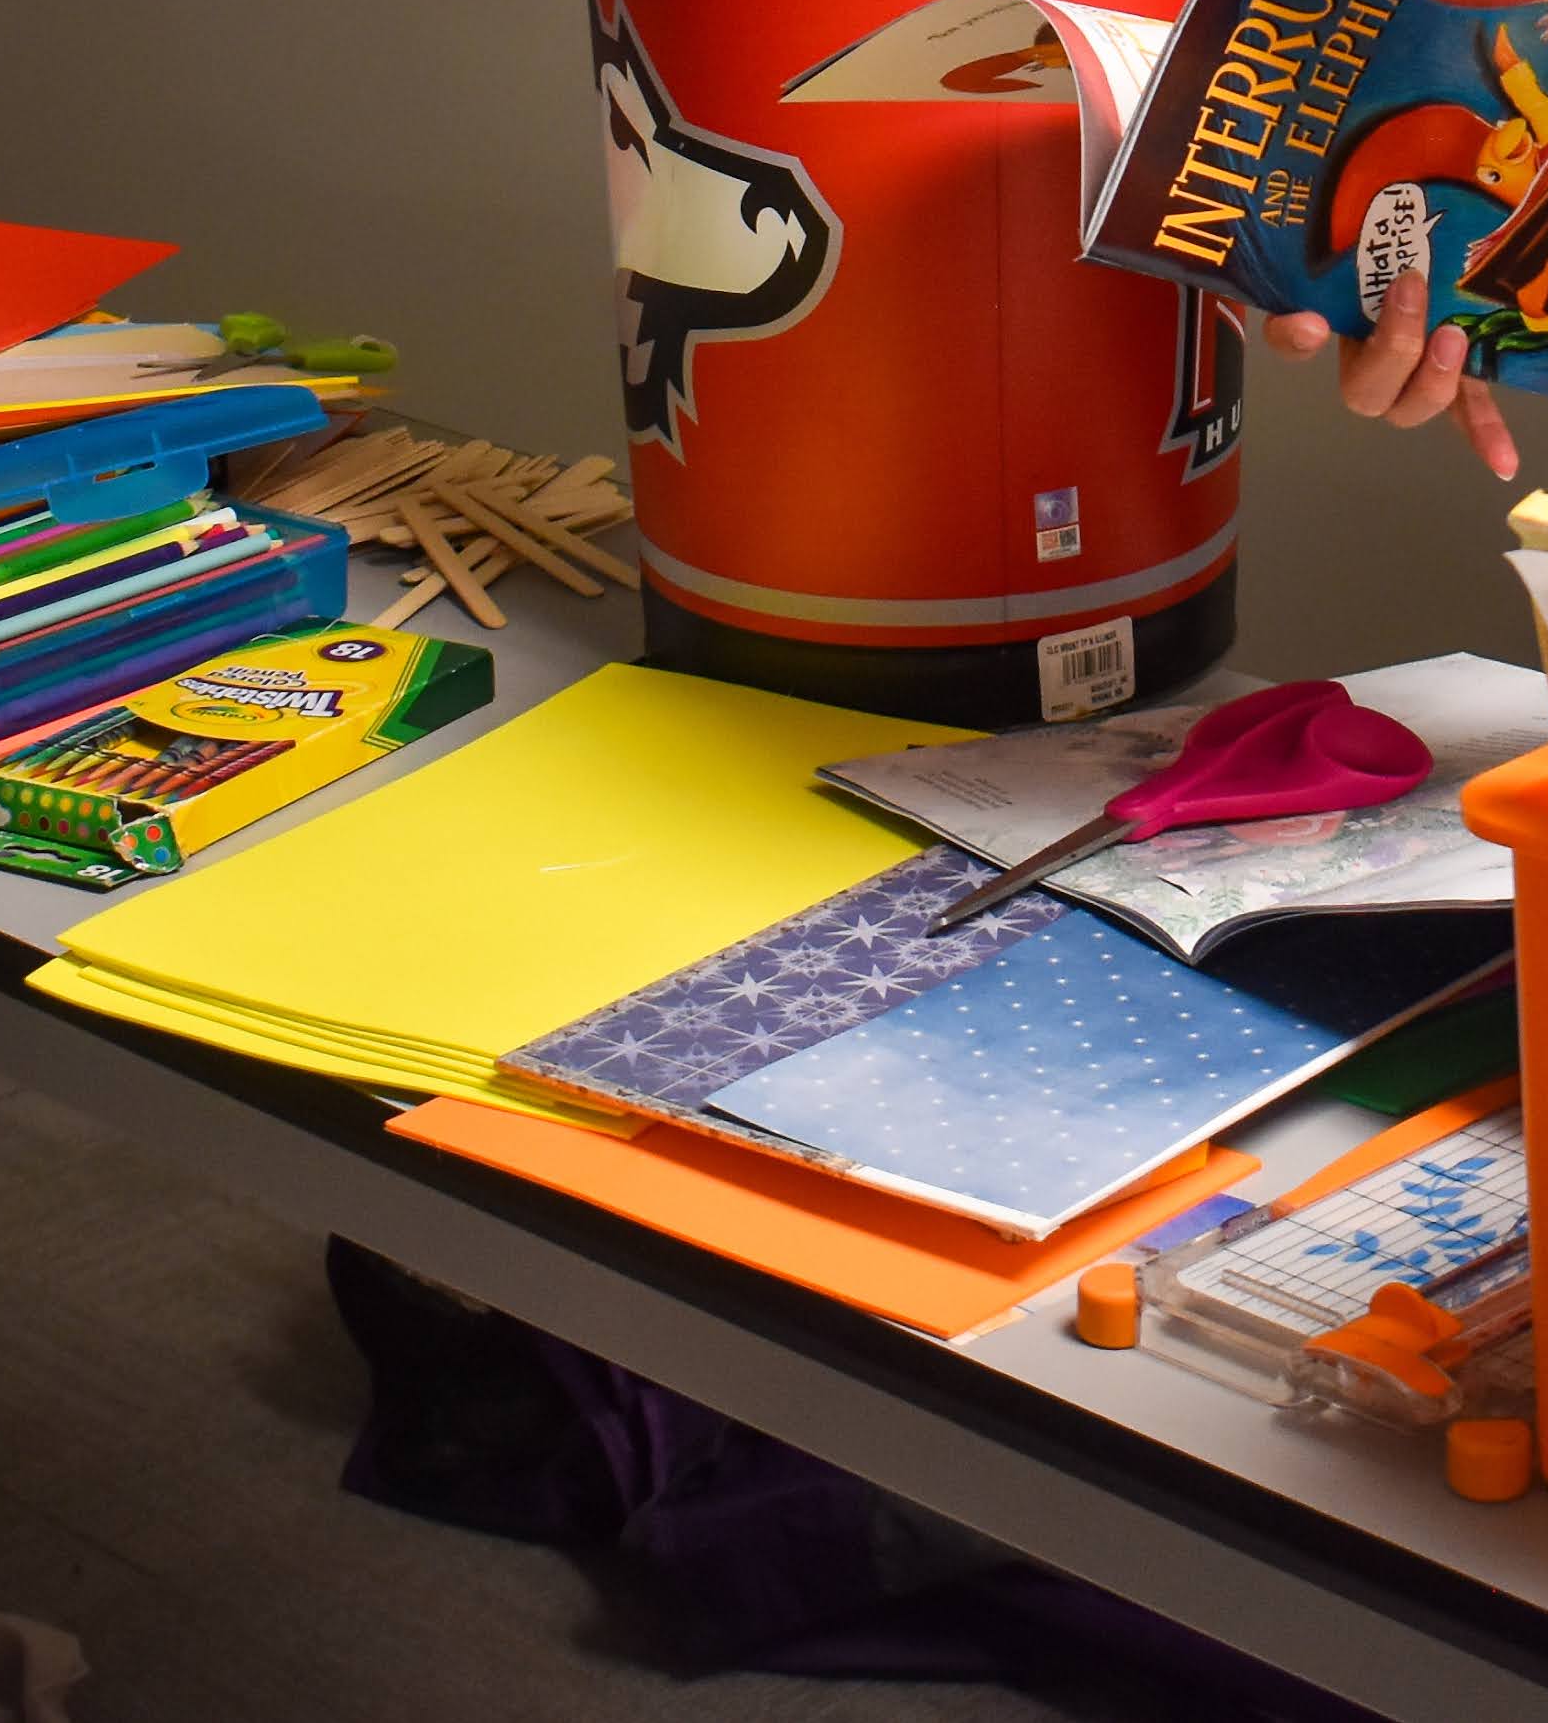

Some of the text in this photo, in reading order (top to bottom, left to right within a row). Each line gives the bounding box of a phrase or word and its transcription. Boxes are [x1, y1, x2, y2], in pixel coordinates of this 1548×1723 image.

[1259, 169, 1290, 228] AND
[1284, 176, 1313, 225] THE
[329, 642, 375, 660] 18
[207, 670, 308, 688] Colored
[226, 665, 307, 679] Pencils
[177, 677, 337, 717] Twistables
[76, 864, 125, 880] 18
